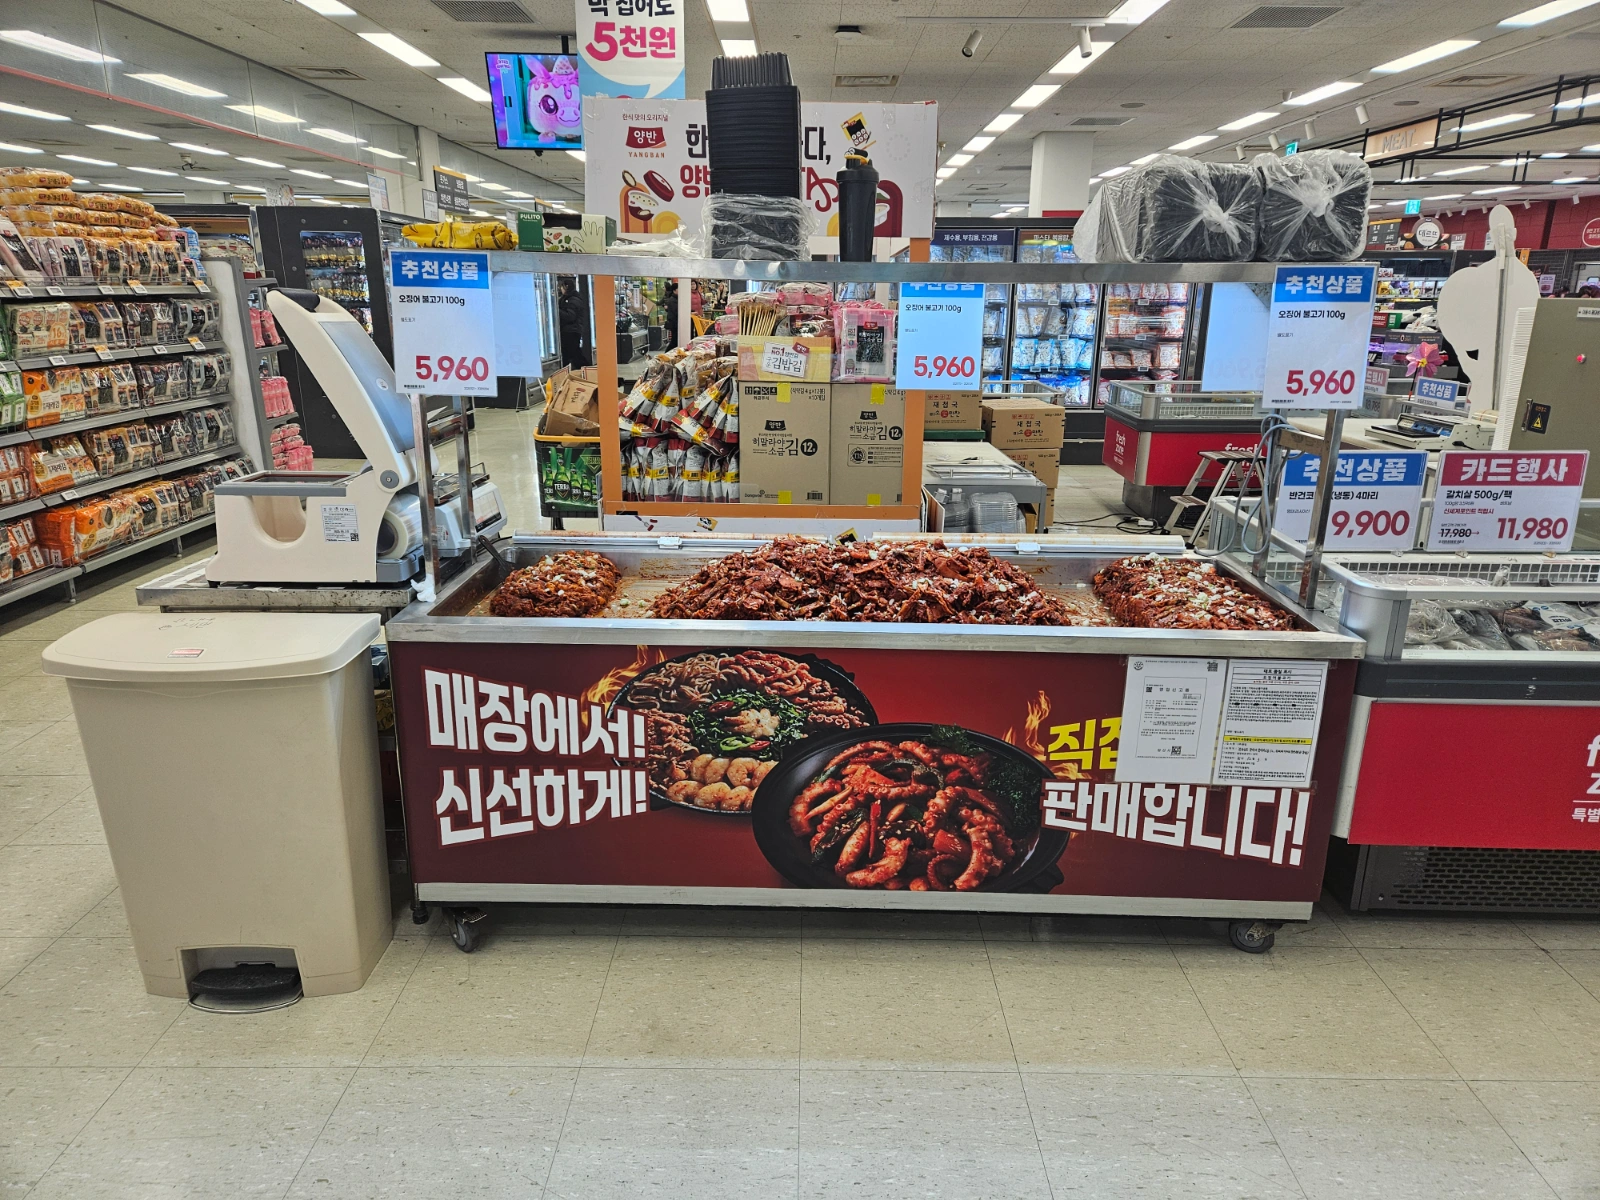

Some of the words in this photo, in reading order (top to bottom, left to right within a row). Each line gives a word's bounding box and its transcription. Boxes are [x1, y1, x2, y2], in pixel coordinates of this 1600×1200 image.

[585, 22, 676, 62] 5천원
[622, 113, 633, 121] 한식
[647, 113, 669, 121] 오리지널
[633, 130, 657, 144] 양반
[1381, 128, 1416, 153] MEAT
[628, 151, 666, 159] YANGBAN
[401, 259, 479, 281] 추천상품
[1284, 275, 1364, 295] 추천상품
[398, 294, 421, 304] 오징어
[422, 295, 444, 304] 불고기
[445, 296, 465, 306] 100g
[905, 303, 924, 312] 오징어
[925, 304, 944, 312] 불고기
[945, 304, 962, 313] 100g
[1278, 310, 1301, 319] 오징어
[1302, 310, 1325, 319] 불고기
[1326, 310, 1346, 320] 100g
[415, 355, 489, 382] 5,960
[772, 357, 802, 373] 김밥김
[913, 355, 975, 379] 5,960
[1286, 369, 1355, 397] 5,960
[1366, 370, 1384, 384] 드행사
[1421, 381, 1453, 399] 추천상품
[876, 425, 888, 441] 김
[1115, 430, 1126, 446] fresh
[752, 437, 785, 447] 히말라야
[785, 437, 799, 457] 김
[1303, 457, 1407, 482] 추천상품
[1460, 457, 1569, 482] 카드행사
[1289, 491, 1354, 500] 반건코(냉동)
[1355, 491, 1379, 500] 4마리
[1446, 490, 1473, 499] 갈치살
[1474, 489, 1513, 501] 500g/팩
[1331, 510, 1410, 538] 9,900
[1440, 528, 1472, 538] 17,980
[1497, 517, 1569, 541] 11,980
[424, 669, 645, 759] 매장에서!
[436, 768, 647, 846] 신선하게!
[1043, 782, 1310, 866] 판매합니다!
